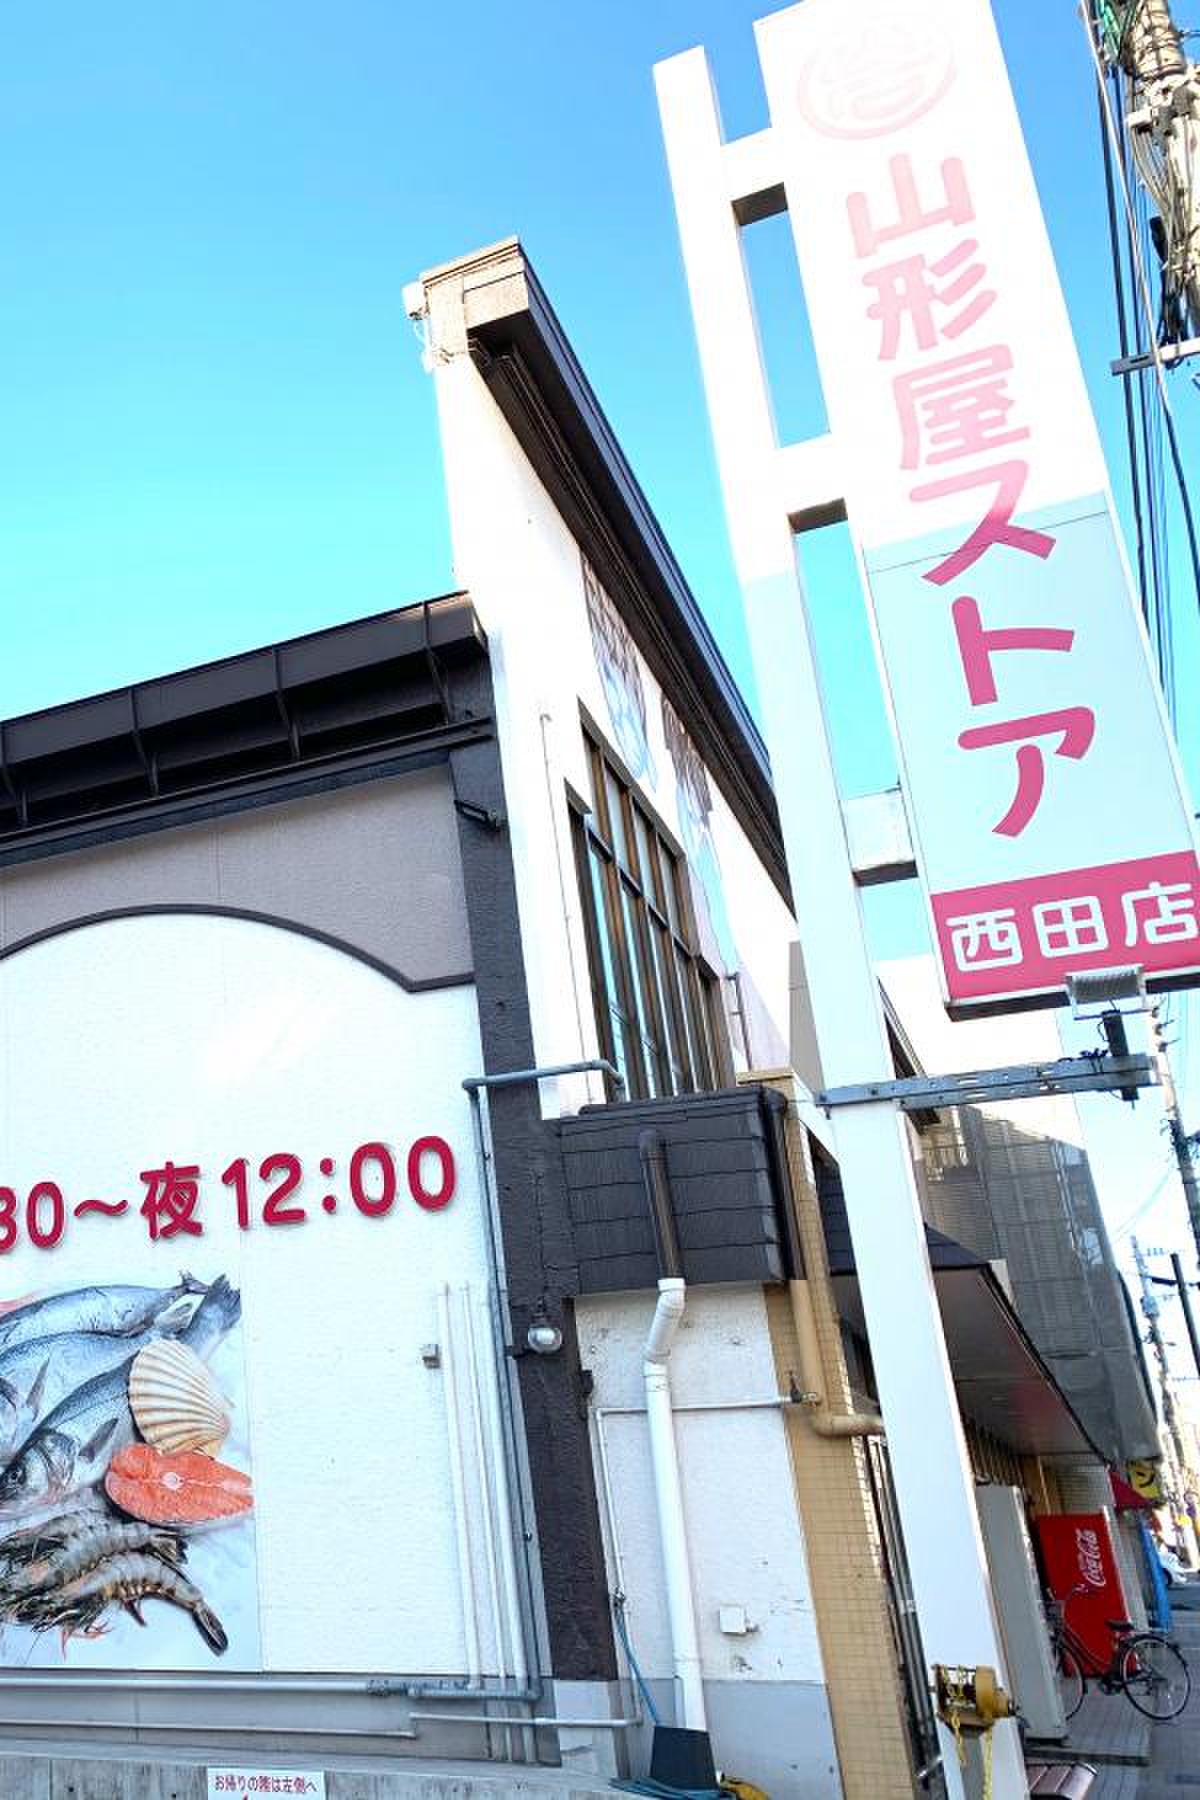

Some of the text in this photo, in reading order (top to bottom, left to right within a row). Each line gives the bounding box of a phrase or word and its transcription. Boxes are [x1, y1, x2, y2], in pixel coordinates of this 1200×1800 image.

[845, 152, 1095, 838] 山形屋ストア
[946, 881, 1200, 972] 西田店
